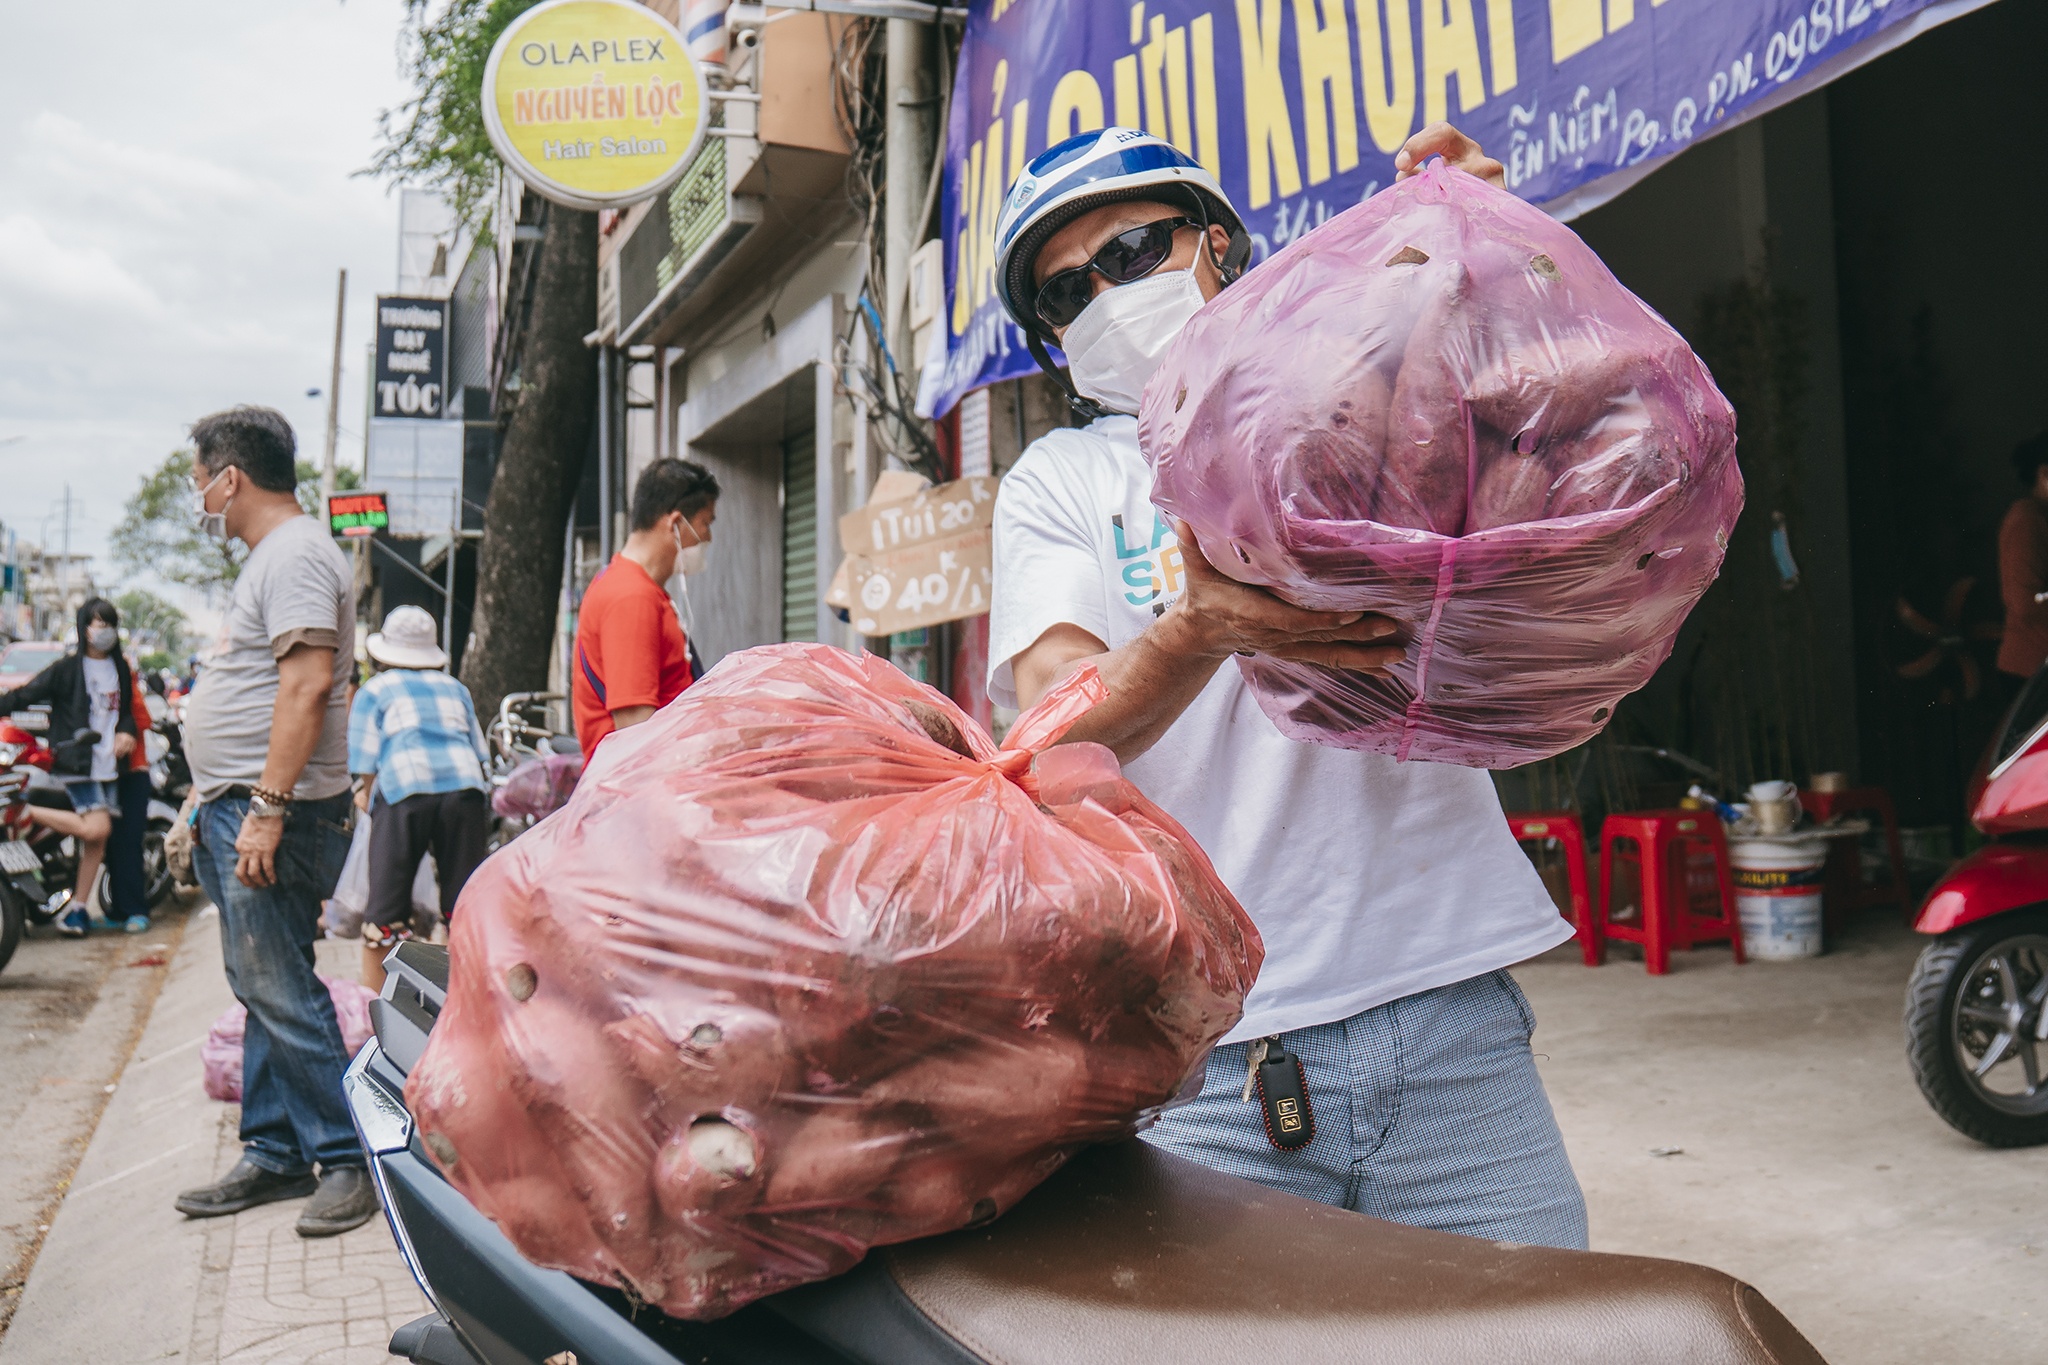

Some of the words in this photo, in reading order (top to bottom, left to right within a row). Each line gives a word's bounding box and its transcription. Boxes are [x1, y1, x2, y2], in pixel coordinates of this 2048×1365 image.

[520, 38, 665, 67] OLAPLEX
[1764, 0, 1892, 83] 09812
[514, 73, 626, 125] NGUYỄN
[634, 76, 683, 125] LỘC
[543, 138, 595, 161] Hair
[600, 136, 667, 157] Salon
[377, 373, 441, 416] TÓC
